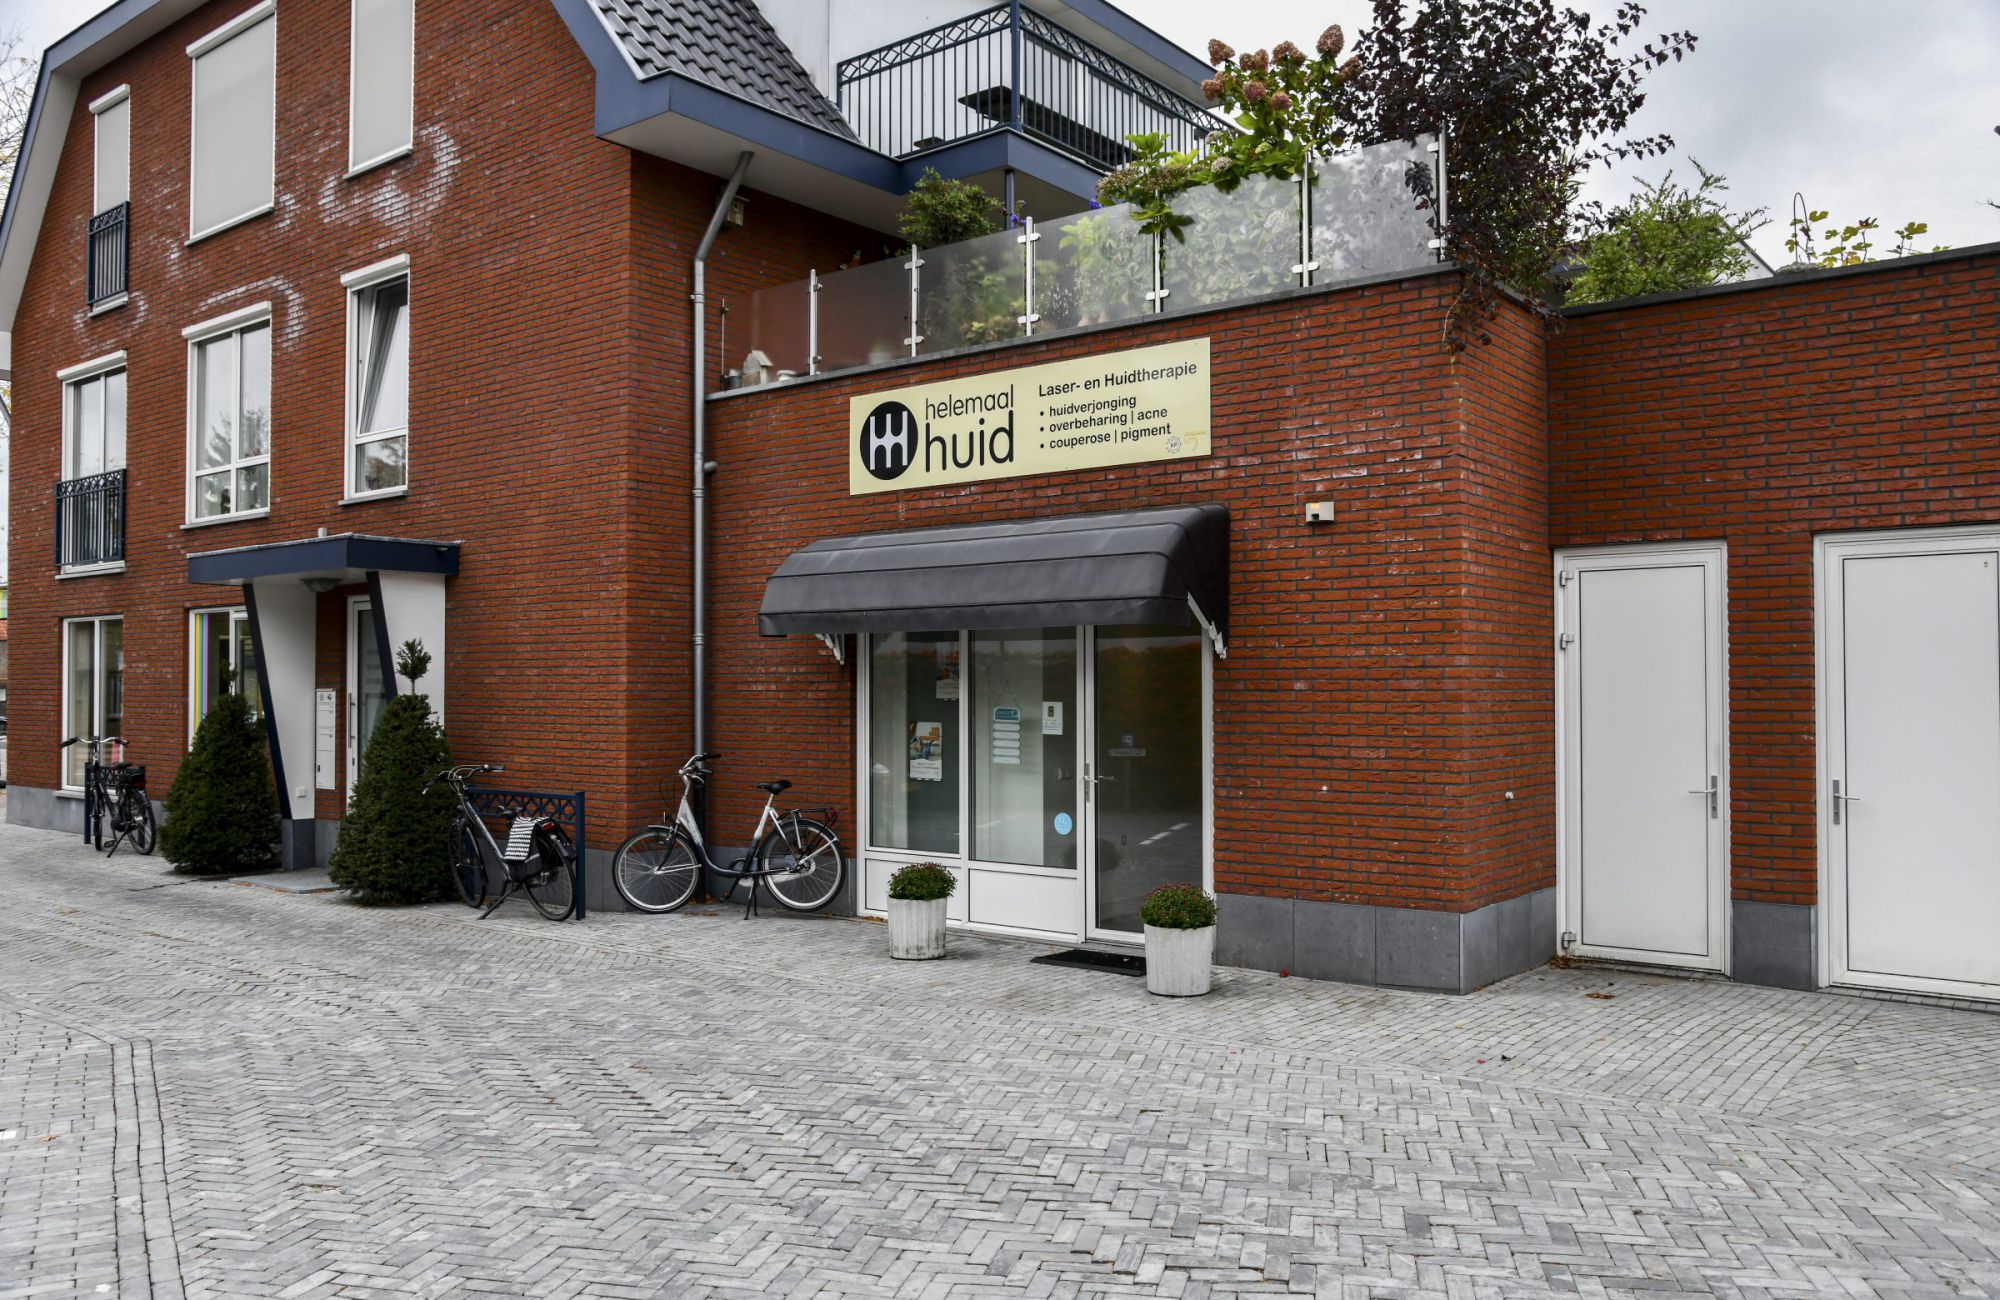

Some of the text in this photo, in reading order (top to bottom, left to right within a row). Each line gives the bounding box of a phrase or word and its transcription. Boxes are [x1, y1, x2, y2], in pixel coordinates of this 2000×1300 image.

[1038, 361, 1198, 398] Laser- en Huidtherapie
[925, 383, 1014, 421] helemaal
[1049, 395, 1137, 418] huidverjonging
[1049, 407, 1168, 433] overbeharing acne
[1049, 422, 1172, 449] couperose pigment
[925, 409, 1014, 473] huid
